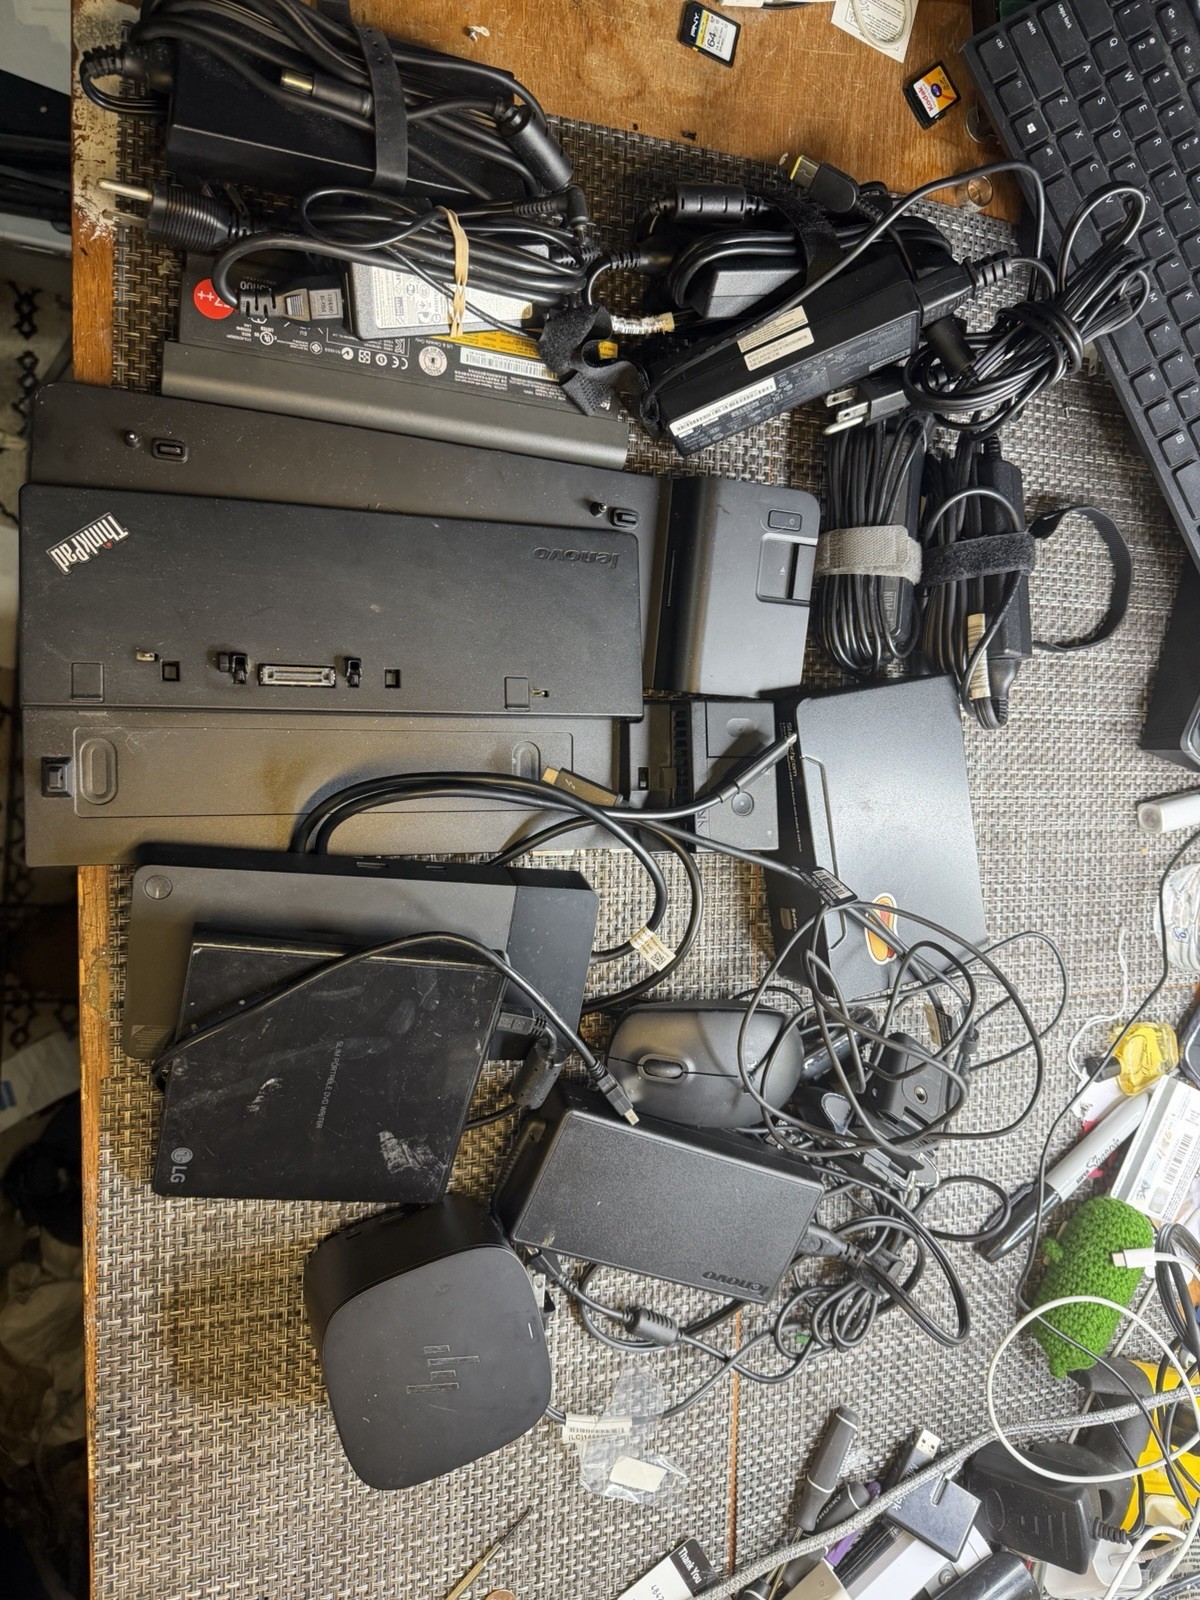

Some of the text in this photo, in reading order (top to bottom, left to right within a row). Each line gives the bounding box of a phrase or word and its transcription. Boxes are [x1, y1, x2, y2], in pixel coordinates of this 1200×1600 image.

[690, 12, 700, 37] PNY
[1026, 21, 1037, 35] shift
[706, 32, 716, 48] 64
[995, 38, 1004, 49] ctrl
[1109, 37, 1119, 47] Q
[1082, 64, 1092, 73] A
[1124, 71, 1135, 82] W
[918, 85, 934, 111] Kodak
[1059, 96, 1068, 105] Z
[1097, 97, 1106, 105] S
[1138, 104, 1148, 113] E
[1074, 130, 1084, 139] X
[1112, 130, 1121, 138] D
[1153, 138, 1162, 146] R
[1089, 163, 1098, 172] C
[1127, 162, 1136, 170] F
[1168, 170, 1177, 178] T
[1183, 203, 1192, 211] Y
[1156, 227, 1166, 237] H
[1149, 292, 1158, 303] M
[1184, 291, 1194, 300] K
[50, 513, 128, 573] ThinkPad
[533, 545, 619, 568] lenovo
[334, 1040, 343, 1057] SLIM
[325, 1057, 339, 1091] PORTABLE
[170, 1166, 187, 1184] LG
[702, 1271, 771, 1298] lenovo
[818, 1494, 842, 1520] HUSKY
[679, 1546, 702, 1584] Thank You
